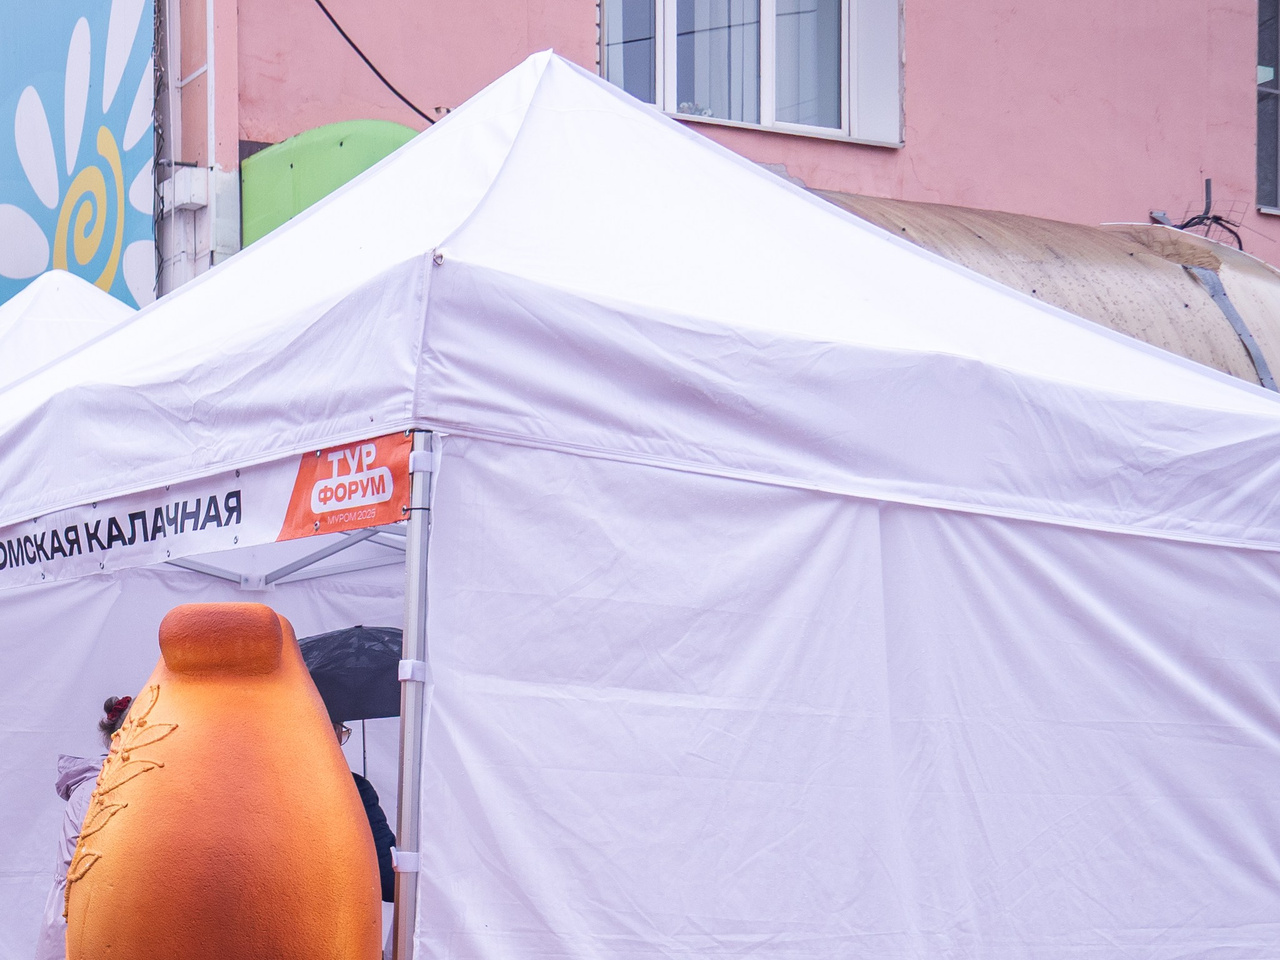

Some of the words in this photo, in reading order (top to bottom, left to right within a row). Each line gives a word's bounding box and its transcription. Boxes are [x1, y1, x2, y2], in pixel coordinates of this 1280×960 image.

[327, 443, 377, 479] ТУР
[318, 474, 386, 506] ФОРУМ
[85, 490, 243, 554] КАЛАЧНАЯ
[327, 511, 357, 525] МУРОМ
